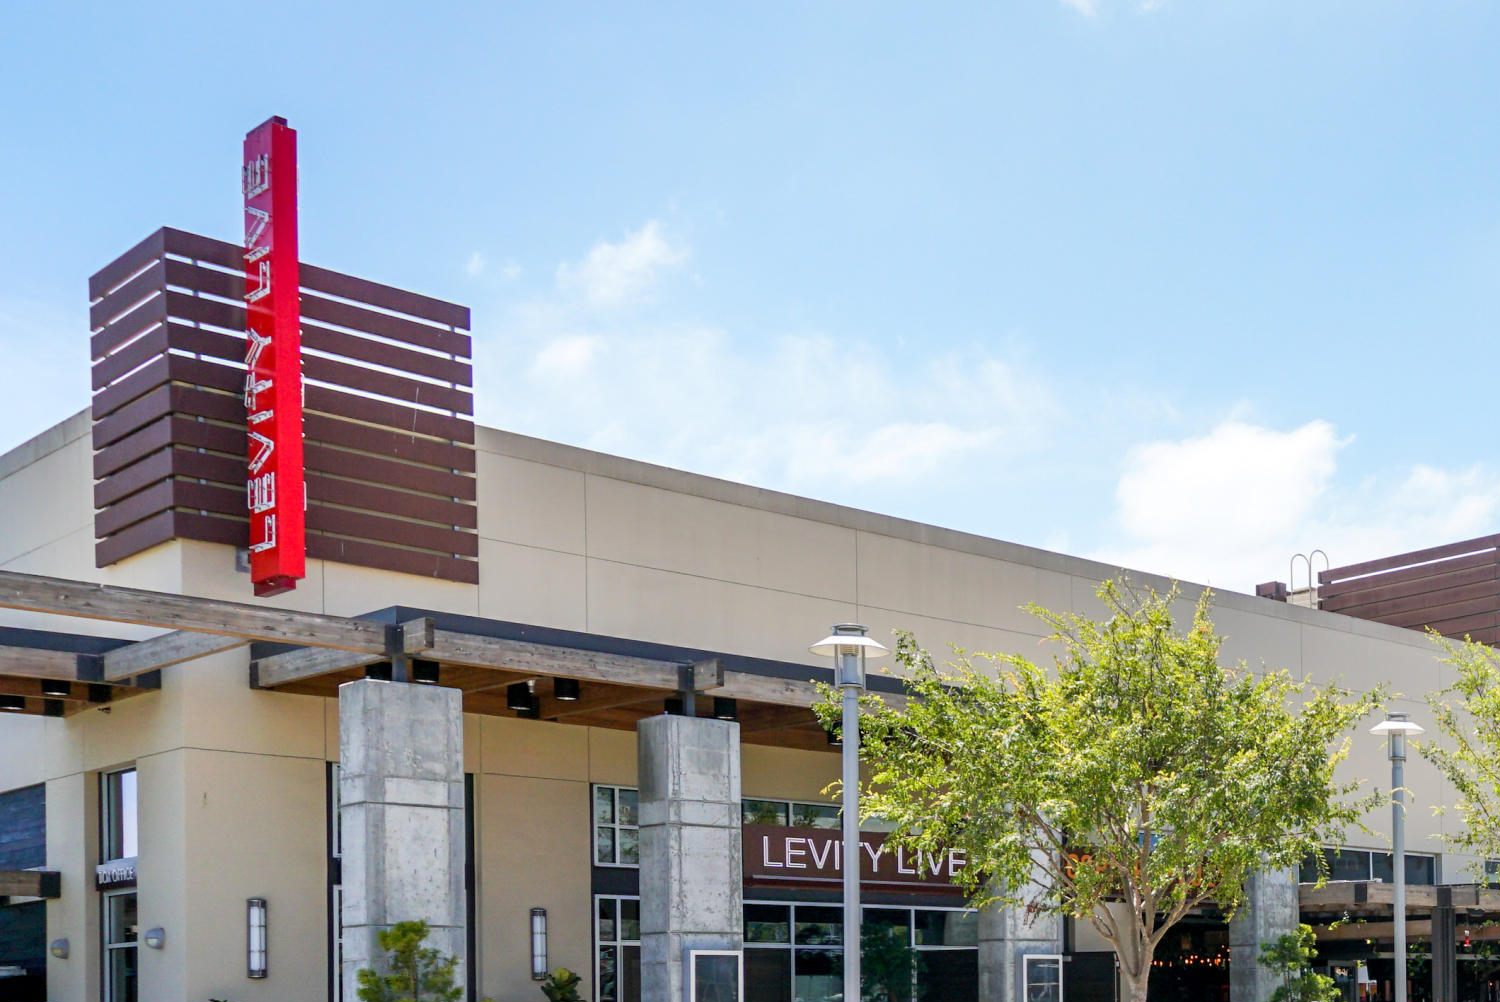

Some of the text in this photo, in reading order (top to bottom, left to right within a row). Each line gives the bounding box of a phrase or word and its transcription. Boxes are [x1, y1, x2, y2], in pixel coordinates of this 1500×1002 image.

[241, 153, 276, 552] LEVITY LIVE
[763, 836, 884, 873] LEVIY
